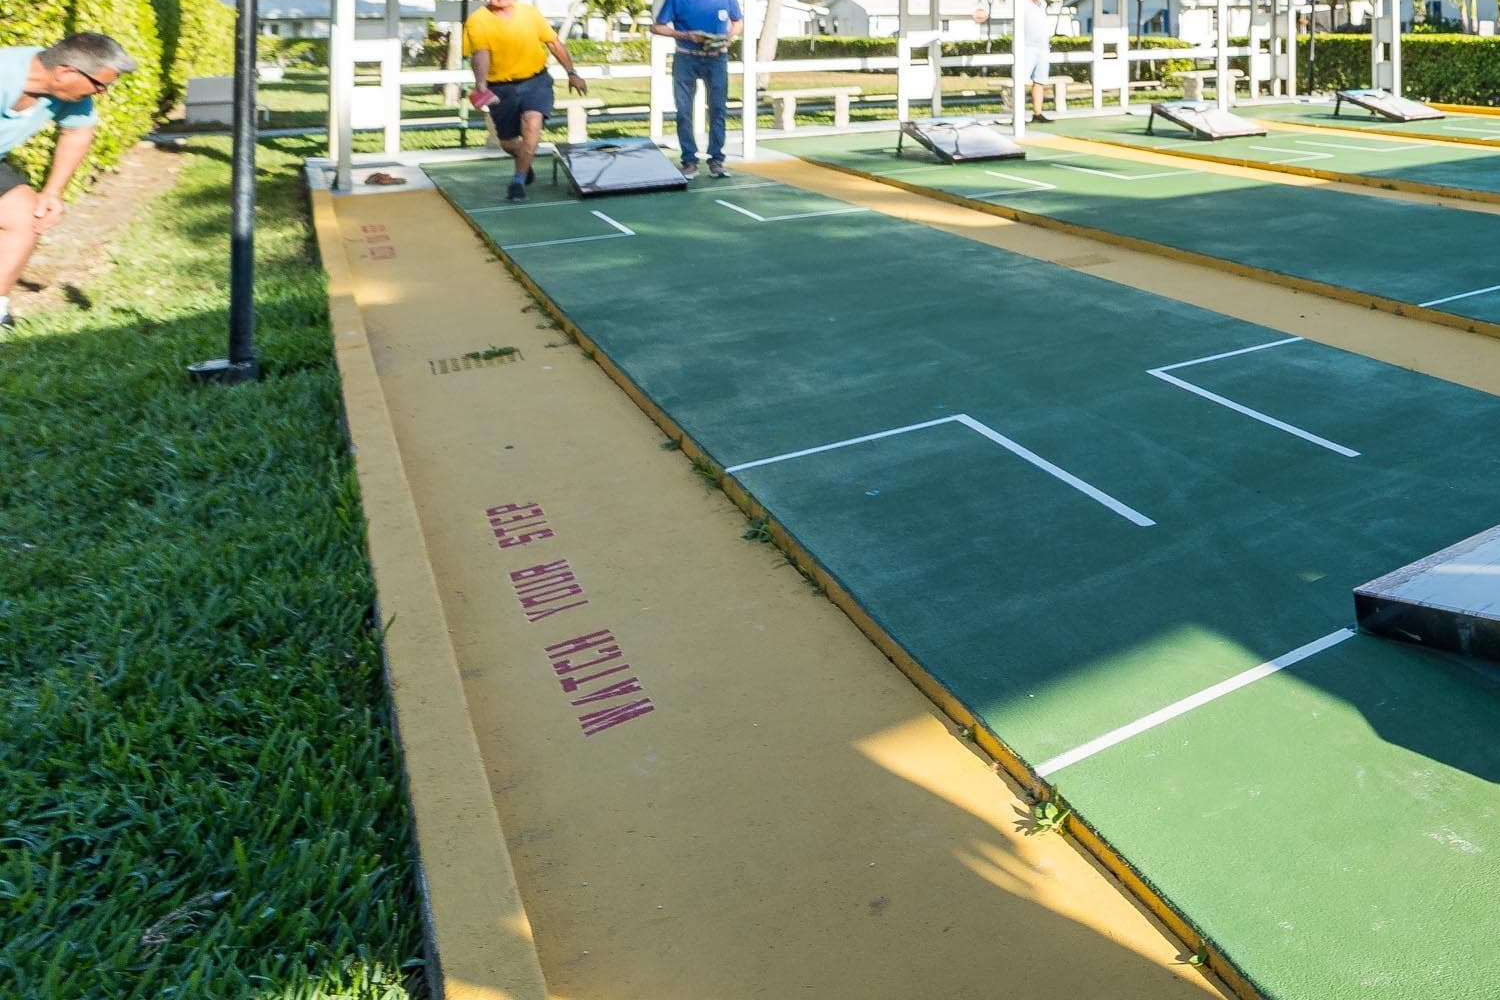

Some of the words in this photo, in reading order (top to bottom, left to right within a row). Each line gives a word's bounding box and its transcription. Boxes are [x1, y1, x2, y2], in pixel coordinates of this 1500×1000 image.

[486, 502, 556, 549] STEP
[509, 559, 590, 624] YOUR
[544, 628, 655, 737] WATCH
